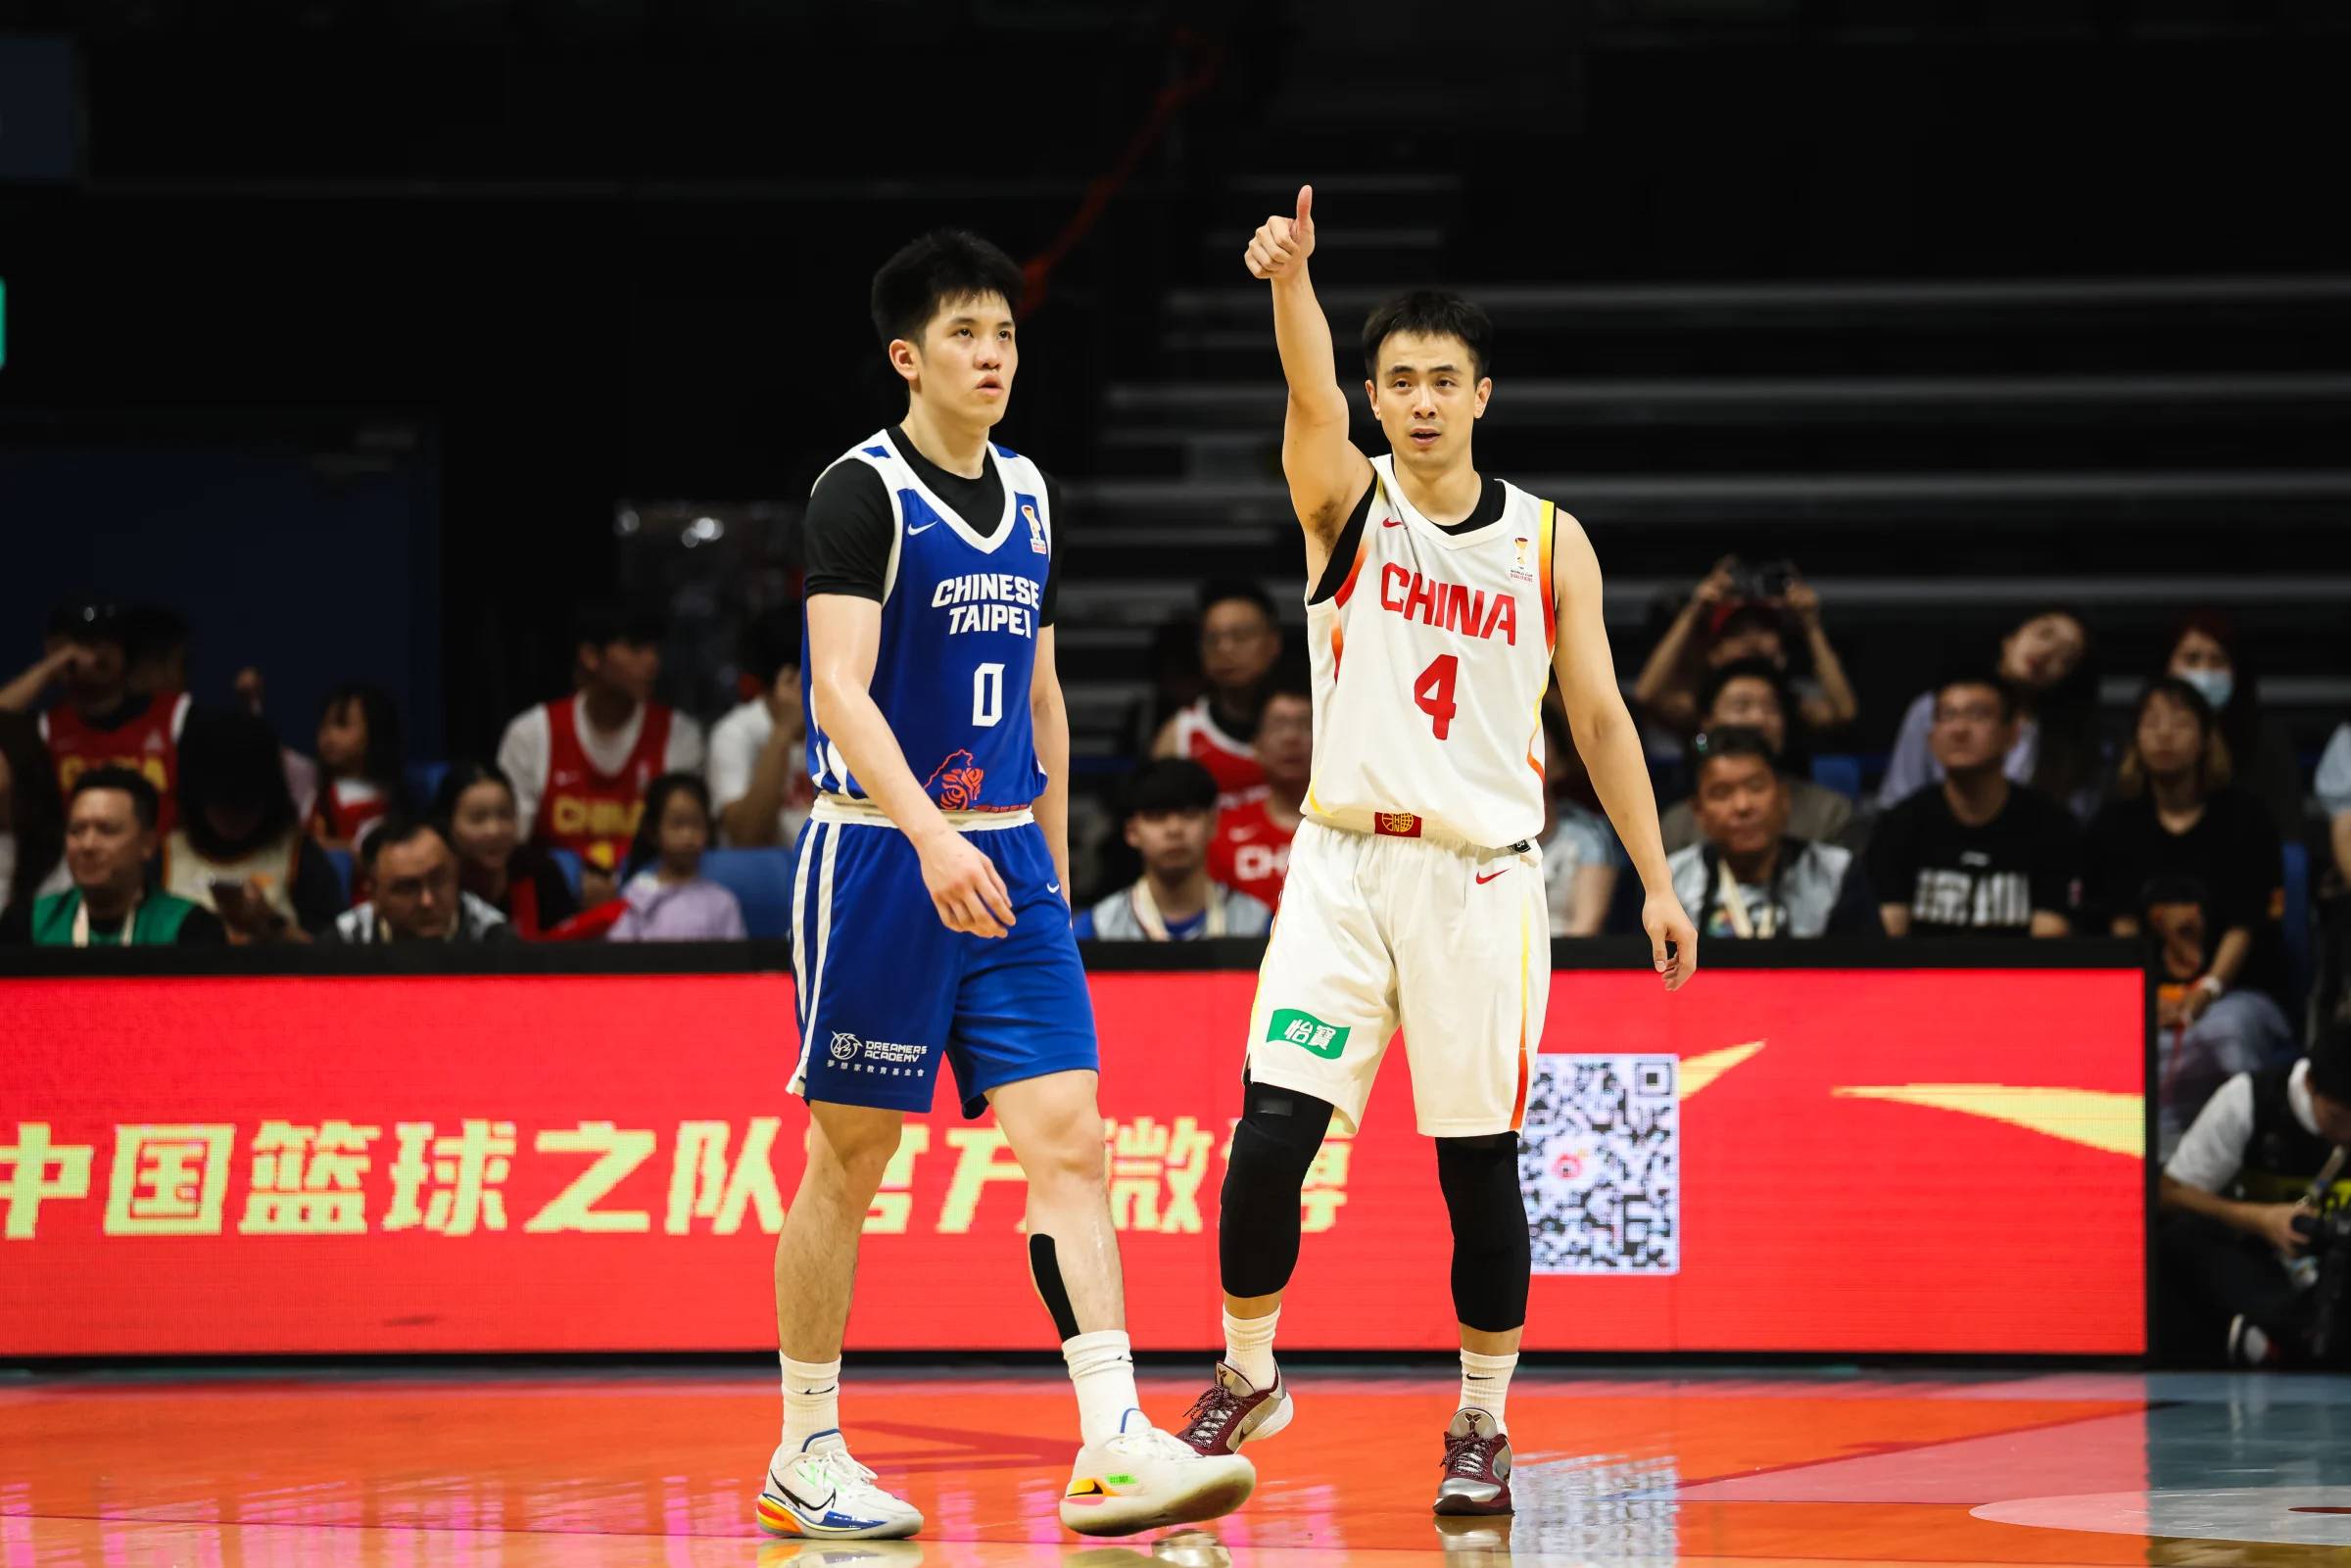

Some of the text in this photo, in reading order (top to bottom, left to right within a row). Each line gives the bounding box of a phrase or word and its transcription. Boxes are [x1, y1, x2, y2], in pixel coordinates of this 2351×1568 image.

[932, 573, 1039, 610] CHINESE
[1381, 562, 1515, 645] CHINA
[948, 603, 1032, 638] TAIPEI
[972, 663, 1005, 727] 0
[1415, 653, 1458, 740] 4
[864, 1051, 920, 1063] ACADEMY
[865, 1041, 928, 1054] DREAMERS
